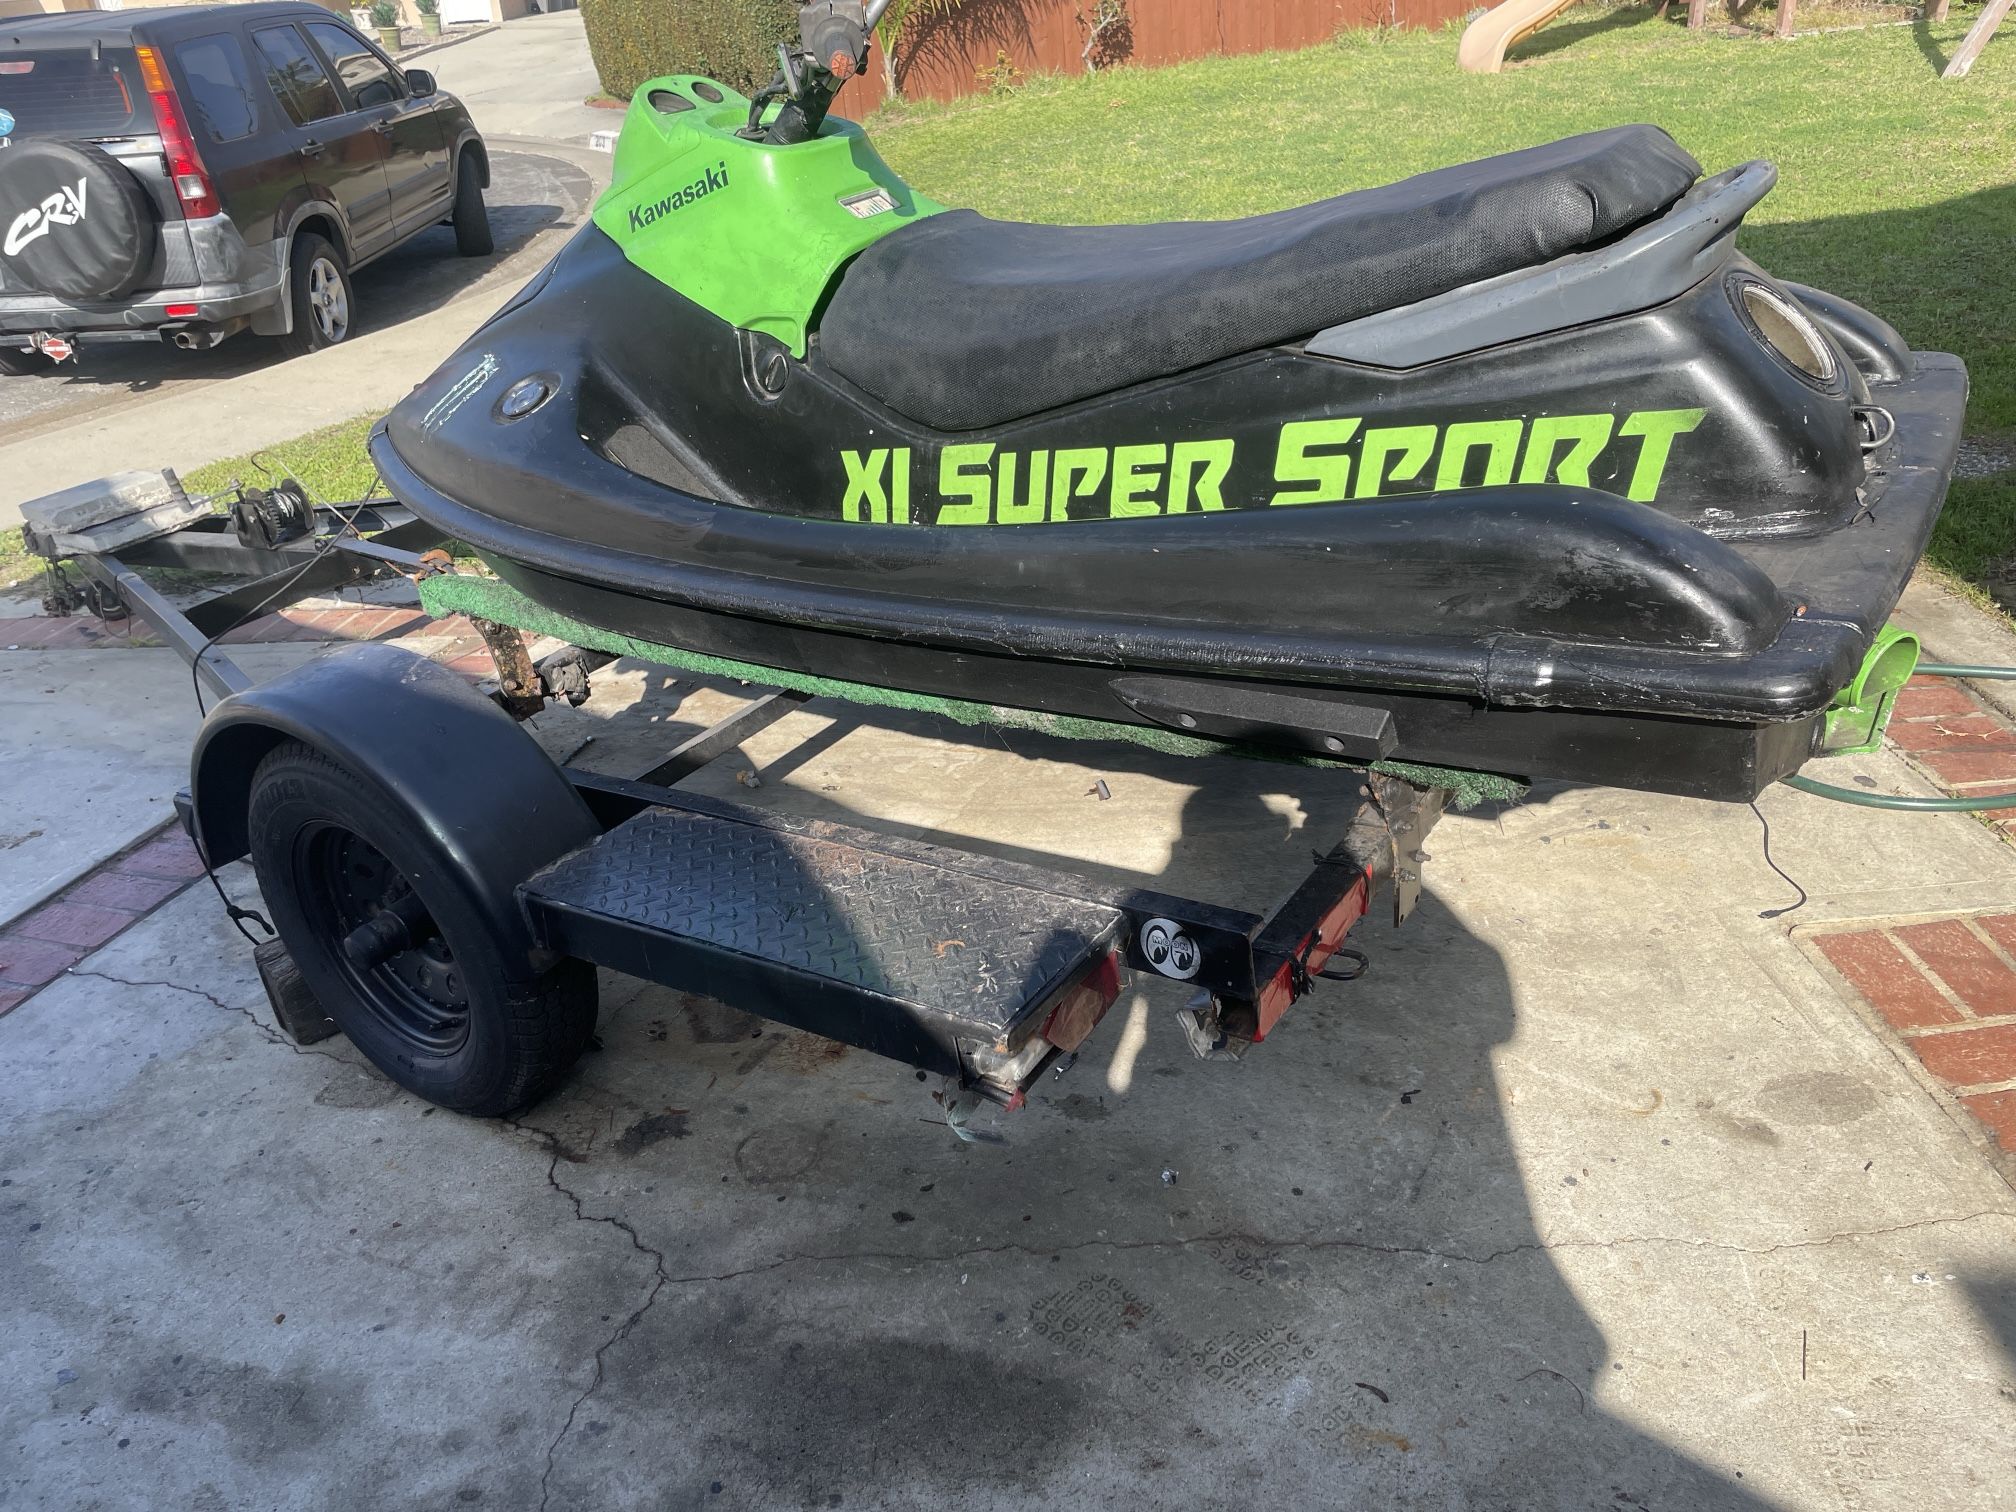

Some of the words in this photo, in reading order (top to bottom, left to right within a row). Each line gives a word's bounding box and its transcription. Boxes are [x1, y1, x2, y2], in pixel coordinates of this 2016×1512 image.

[628, 161, 729, 233] Kawasaki
[936, 439, 1235, 525] SUPER
[1270, 408, 1708, 506] SPORT
[1152, 935, 1189, 952] MOON
